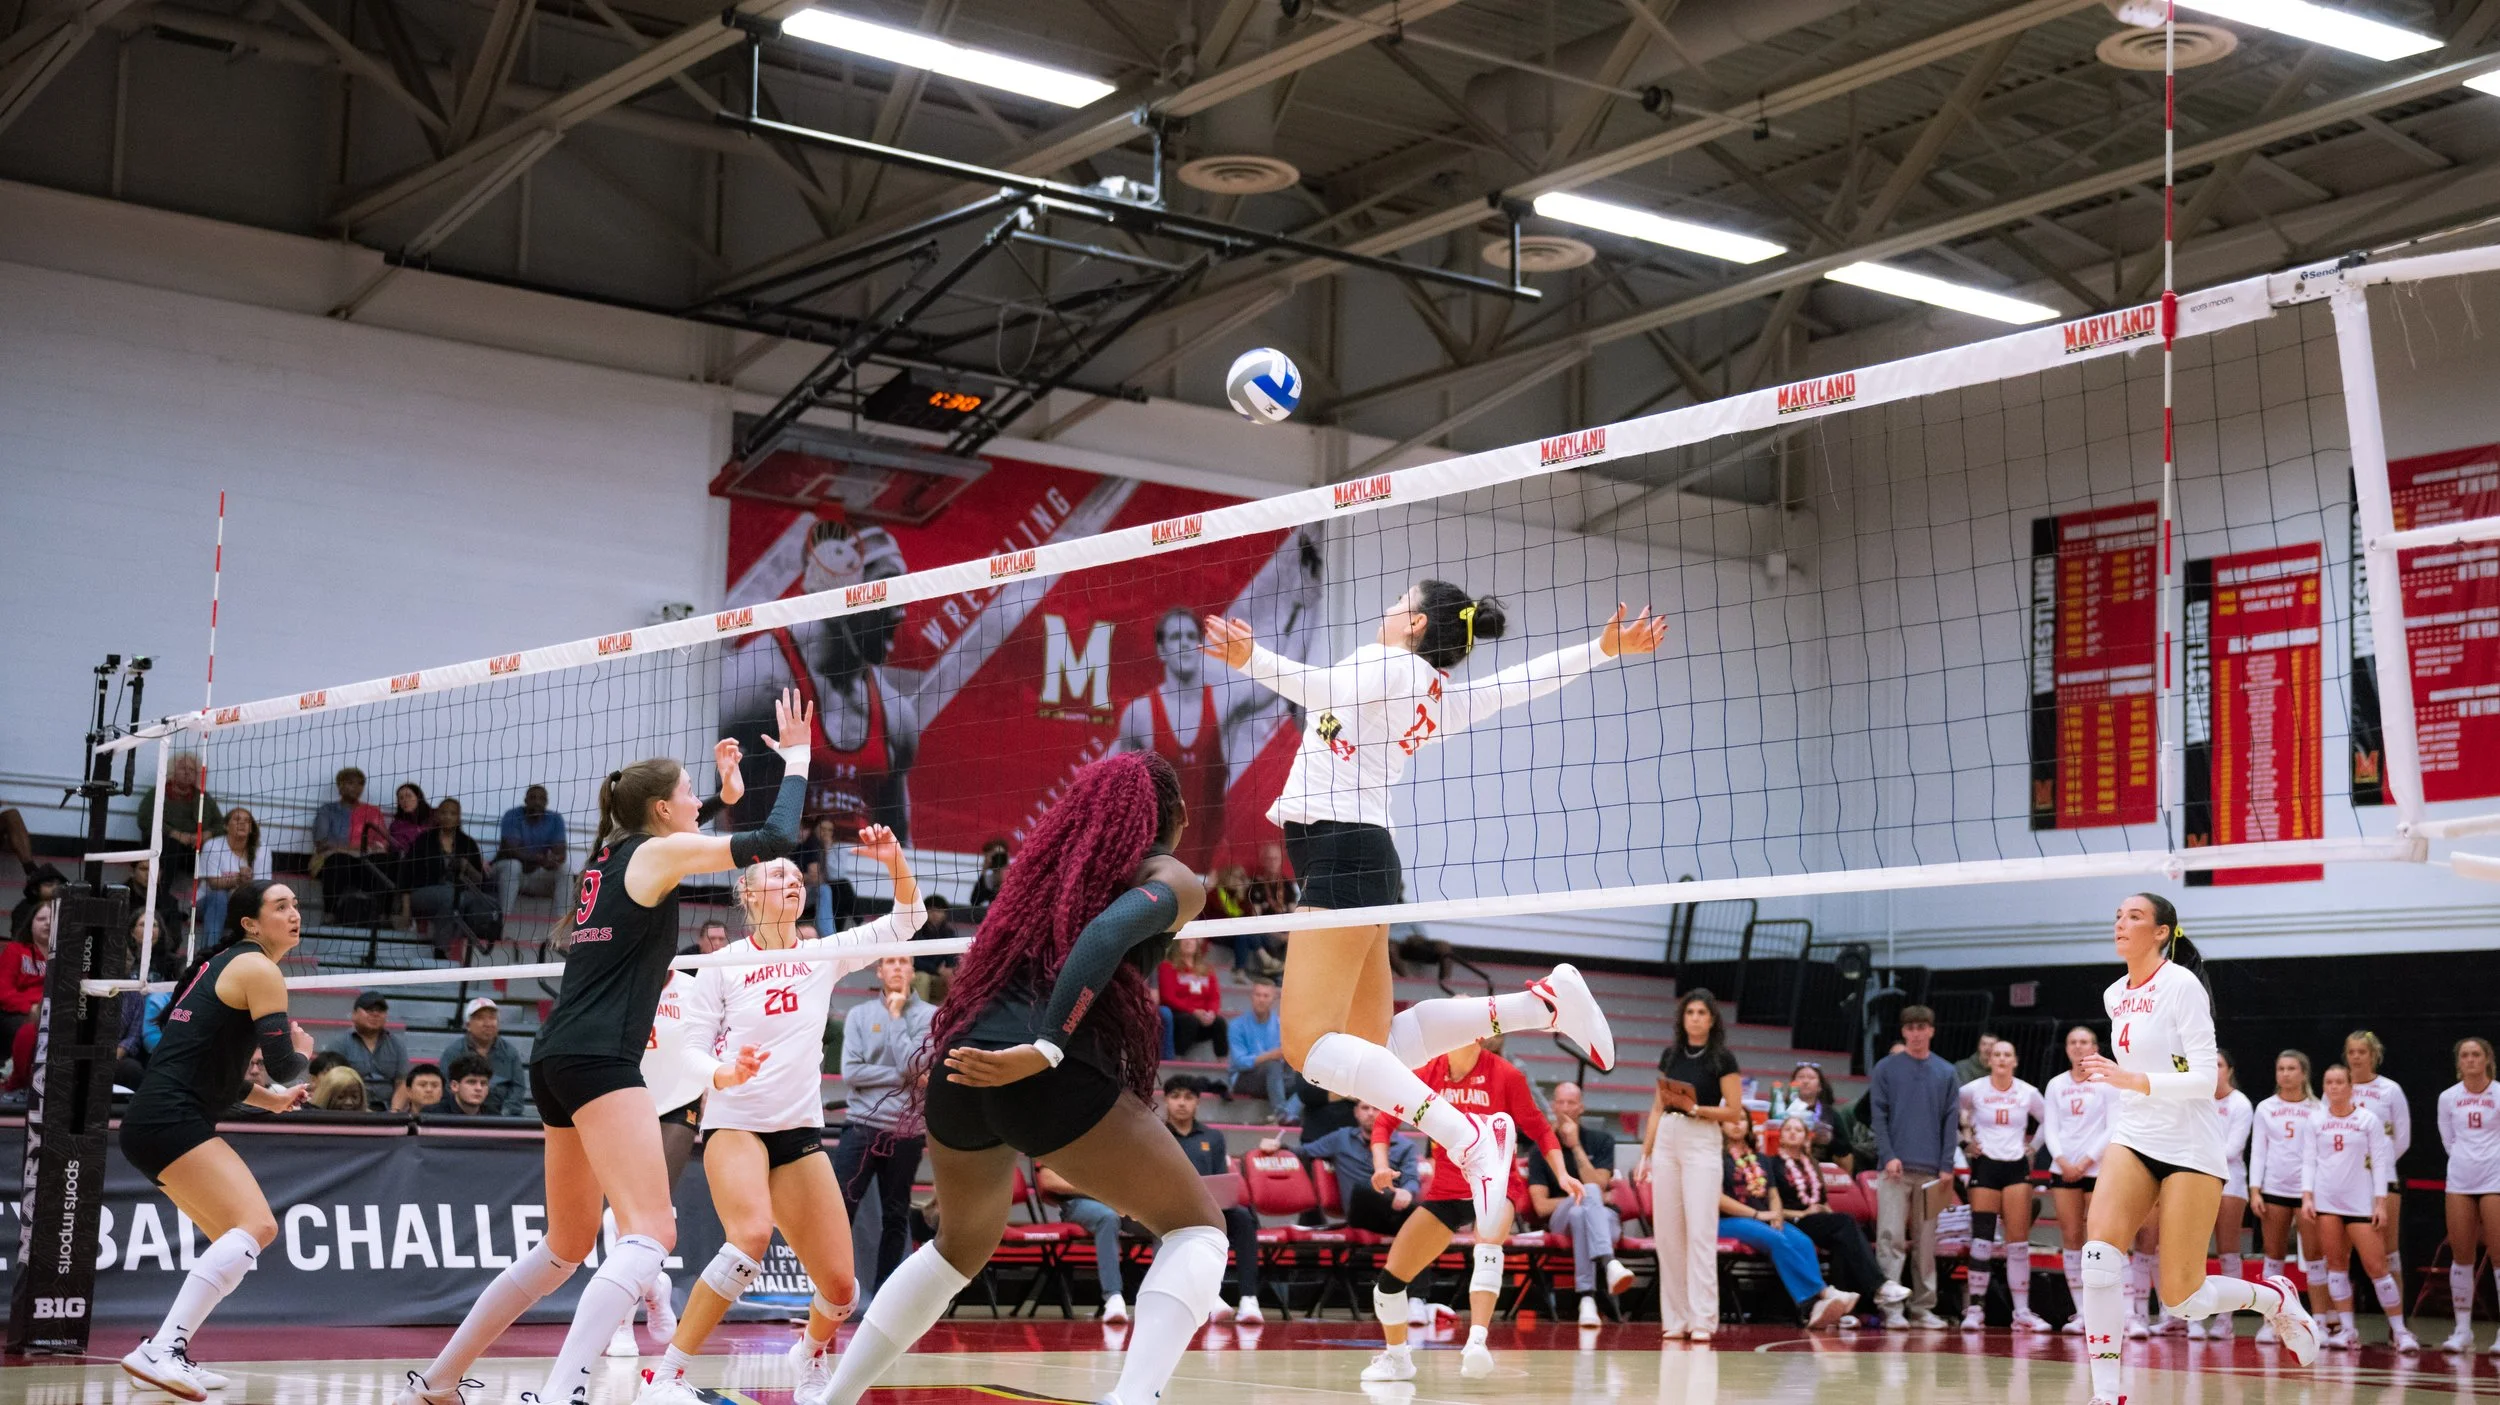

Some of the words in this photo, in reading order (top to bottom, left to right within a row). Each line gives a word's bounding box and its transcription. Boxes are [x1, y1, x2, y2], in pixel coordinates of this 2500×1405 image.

[2063, 304, 2157, 350] MARYLAND
[1778, 373, 1866, 410] MARYLAND
[1541, 428, 1606, 461] MARYLAND
[1334, 474, 1392, 504] MARYLAND
[1151, 514, 1203, 542] MARYLAND
[921, 486, 1071, 650] WREING
[990, 550, 1036, 575] MARYLAND
[845, 581, 887, 603] MARYLAND
[715, 608, 753, 629] MARYLAND
[2033, 557, 2055, 695] WRESTLING
[598, 632, 633, 652] MARYLAND
[489, 654, 521, 672] MARYLAND
[1041, 614, 1116, 711] M
[2186, 600, 2210, 746] WRESTLING
[576, 869, 602, 925] 9
[570, 927, 613, 945] TGERS
[764, 984, 798, 1016] 26
[2119, 1023, 2130, 1053] 4
[1996, 1109, 2009, 1125] 10
[2071, 1098, 2084, 1116] 12
[2468, 1112, 2481, 1129] 19
[2283, 1121, 2294, 1138] 5
[2334, 1134, 2344, 1151] 8
[65, 1160, 80, 1210] sports
[58, 1212, 76, 1275] imports
[284, 1203, 684, 1271] CHALLE
